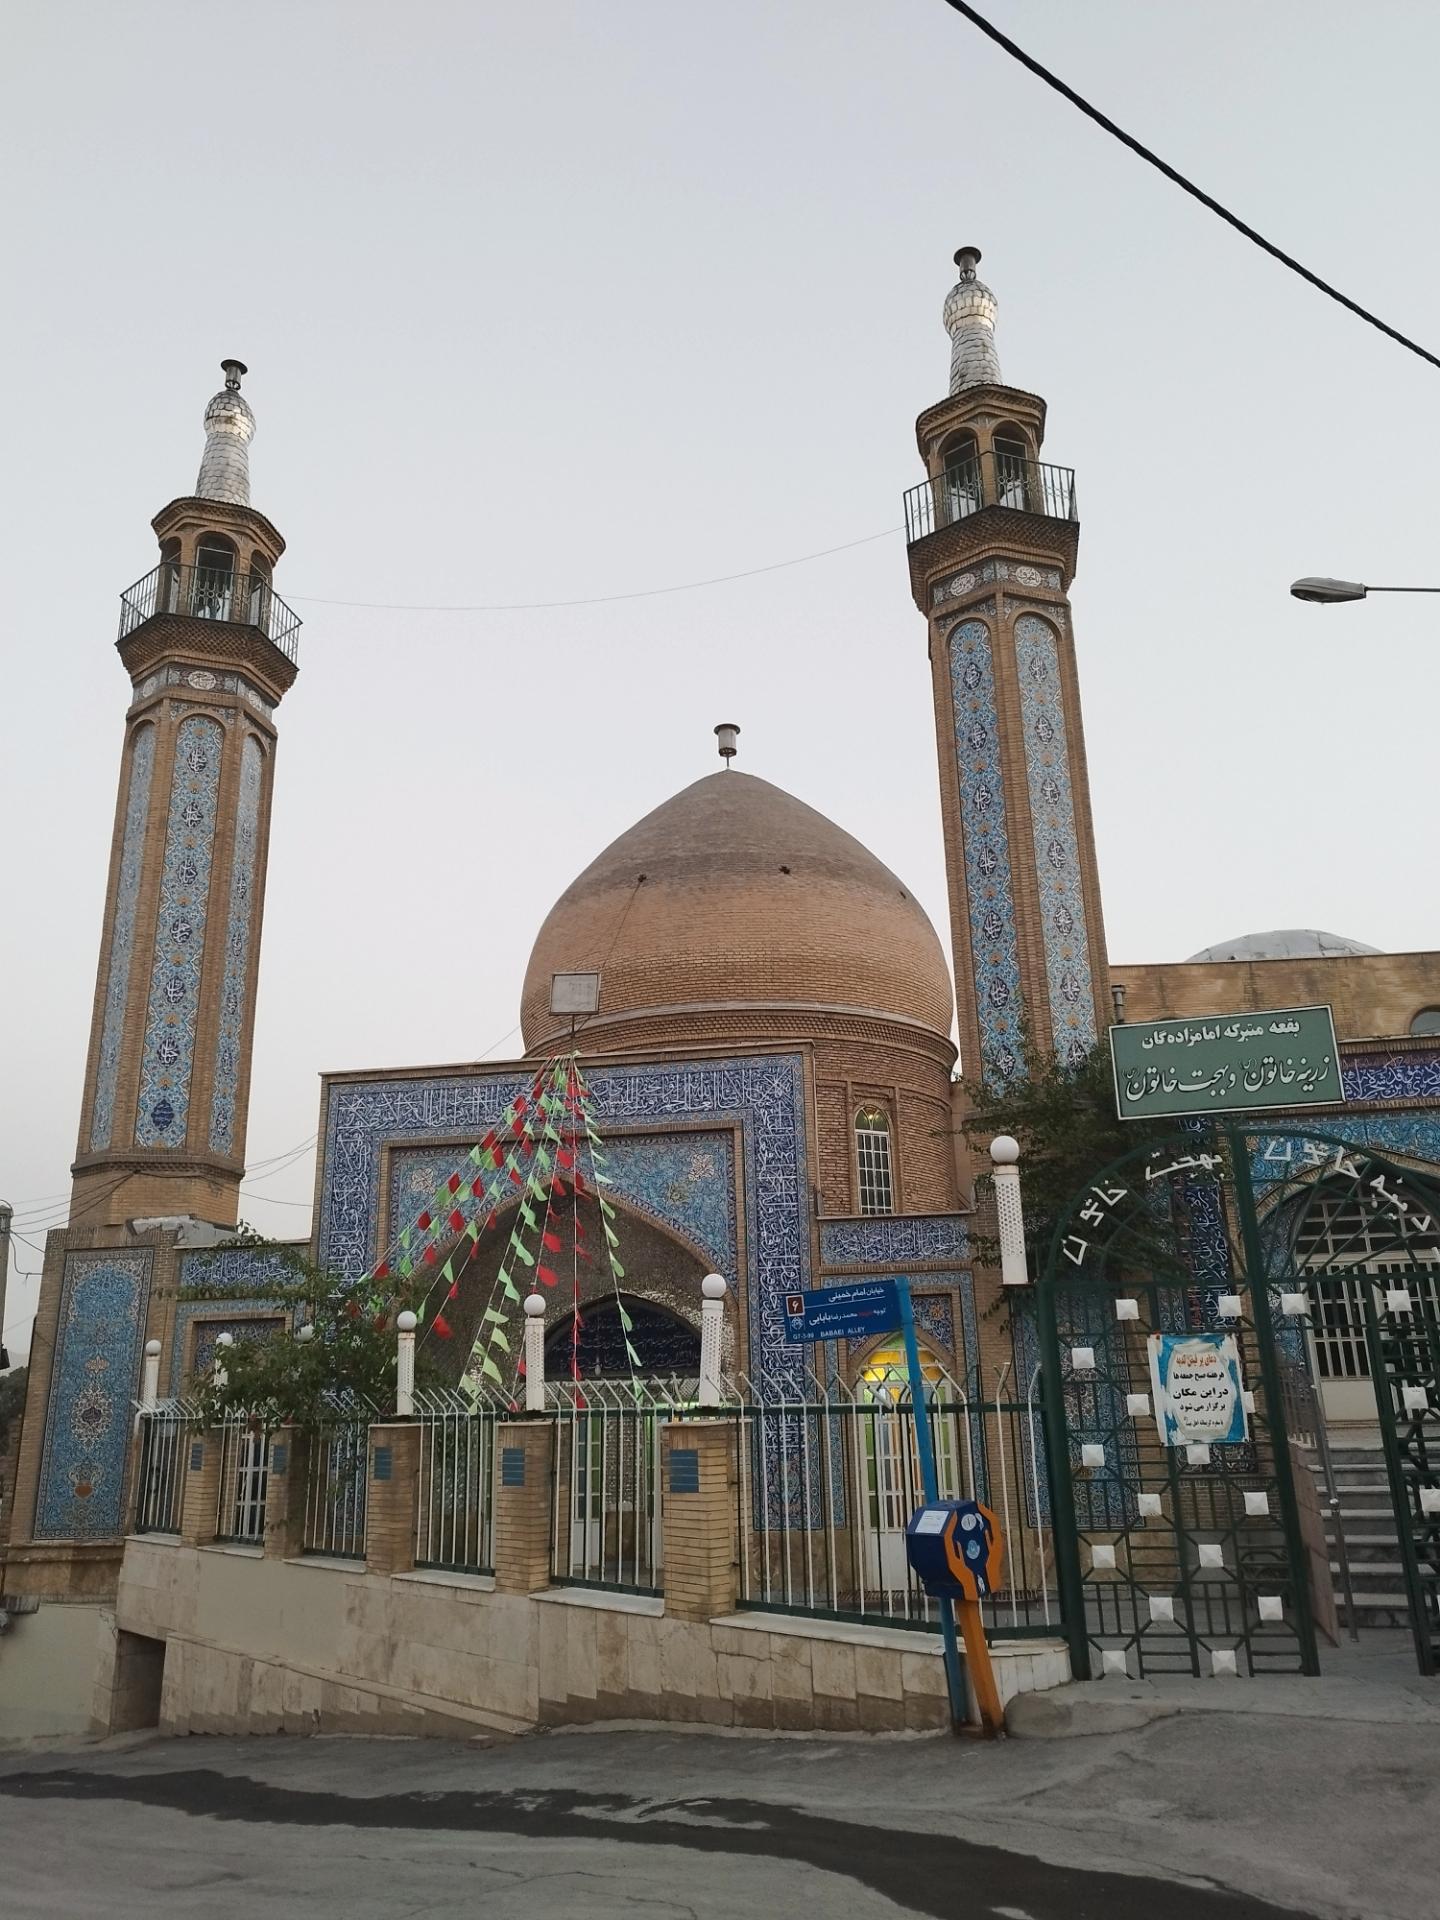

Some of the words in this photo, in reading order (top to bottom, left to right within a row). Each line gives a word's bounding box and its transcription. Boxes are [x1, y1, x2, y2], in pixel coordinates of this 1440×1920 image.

[1224, 1023, 1264, 1042] متبرکه
[1269, 1018, 1300, 1037] بقعه
[1178, 1064, 1229, 1097] بهجت
[1227, 1071, 1236, 1088] و
[1243, 1056, 1296, 1092] خاتون
[1296, 1056, 1330, 1092] زرینه
[1126, 1066, 1178, 1101] خاتون
[828, 1291, 852, 1303] خمینی
[852, 1288, 866, 1301] امام
[866, 1286, 885, 1296] خیابان
[809, 1312, 831, 1326] بابایی
[820, 1329, 845, 1337] BABAEI
[847, 1326, 865, 1334] ALLEY
[1194, 1373, 1206, 1381] صبح
[1217, 1371, 1225, 1381] هر
[1172, 1388, 1197, 1400] مکان
[1200, 1387, 1216, 1399] این
[1218, 1388, 1229, 1398] در
